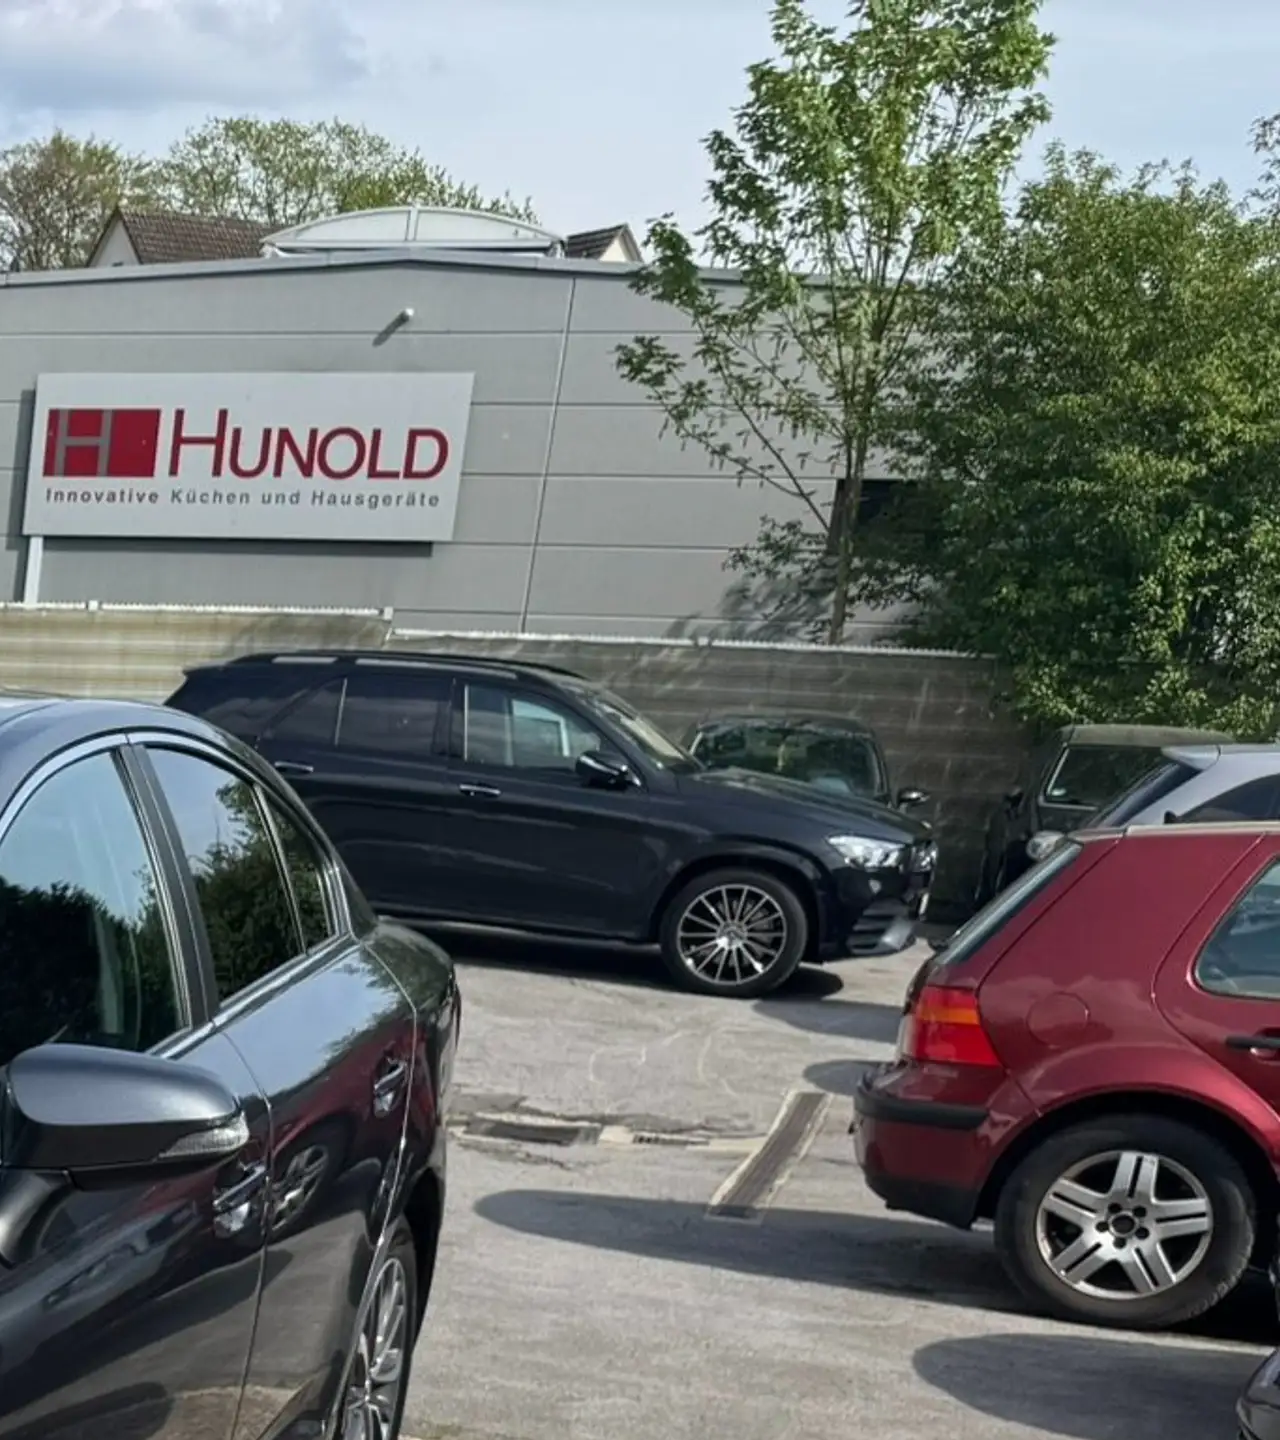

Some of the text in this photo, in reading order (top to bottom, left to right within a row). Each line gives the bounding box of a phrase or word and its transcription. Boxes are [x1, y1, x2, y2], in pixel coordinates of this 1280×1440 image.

[168, 408, 449, 480] HUNOLD
[45, 488, 440, 510] Innovative Küchen und Hausgeräte
